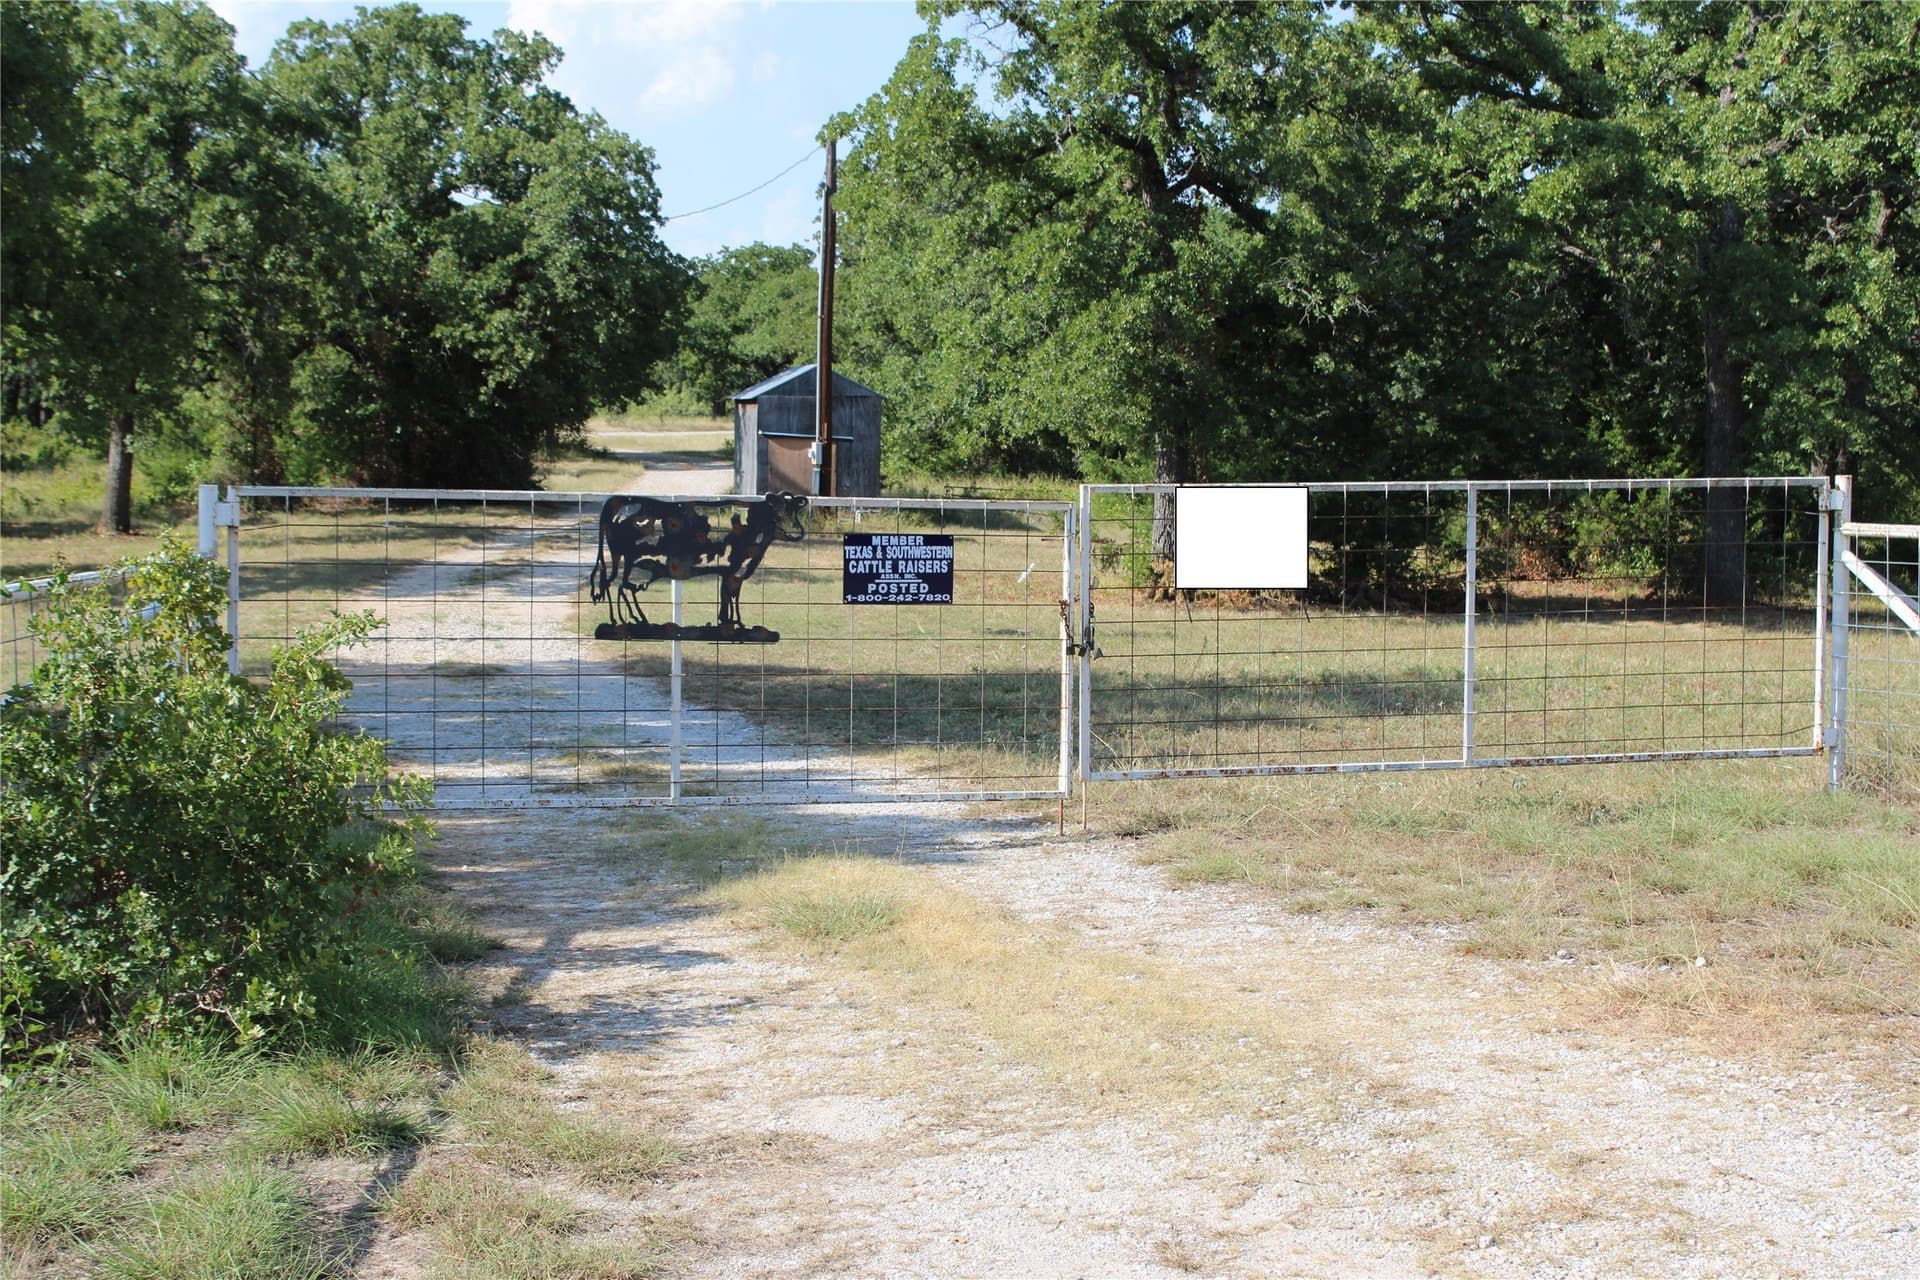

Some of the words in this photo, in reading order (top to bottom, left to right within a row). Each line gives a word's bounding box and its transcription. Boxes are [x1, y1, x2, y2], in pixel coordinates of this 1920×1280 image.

[872, 535, 924, 546] MEMBER
[844, 546, 873, 559] TEXAS
[876, 546, 883, 559] &
[886, 546, 953, 559] SOUTHWESTERN
[849, 560, 893, 574] CATTLE
[868, 583, 929, 593] POSTED
[845, 594, 950, 602] 1-800-242-7820
